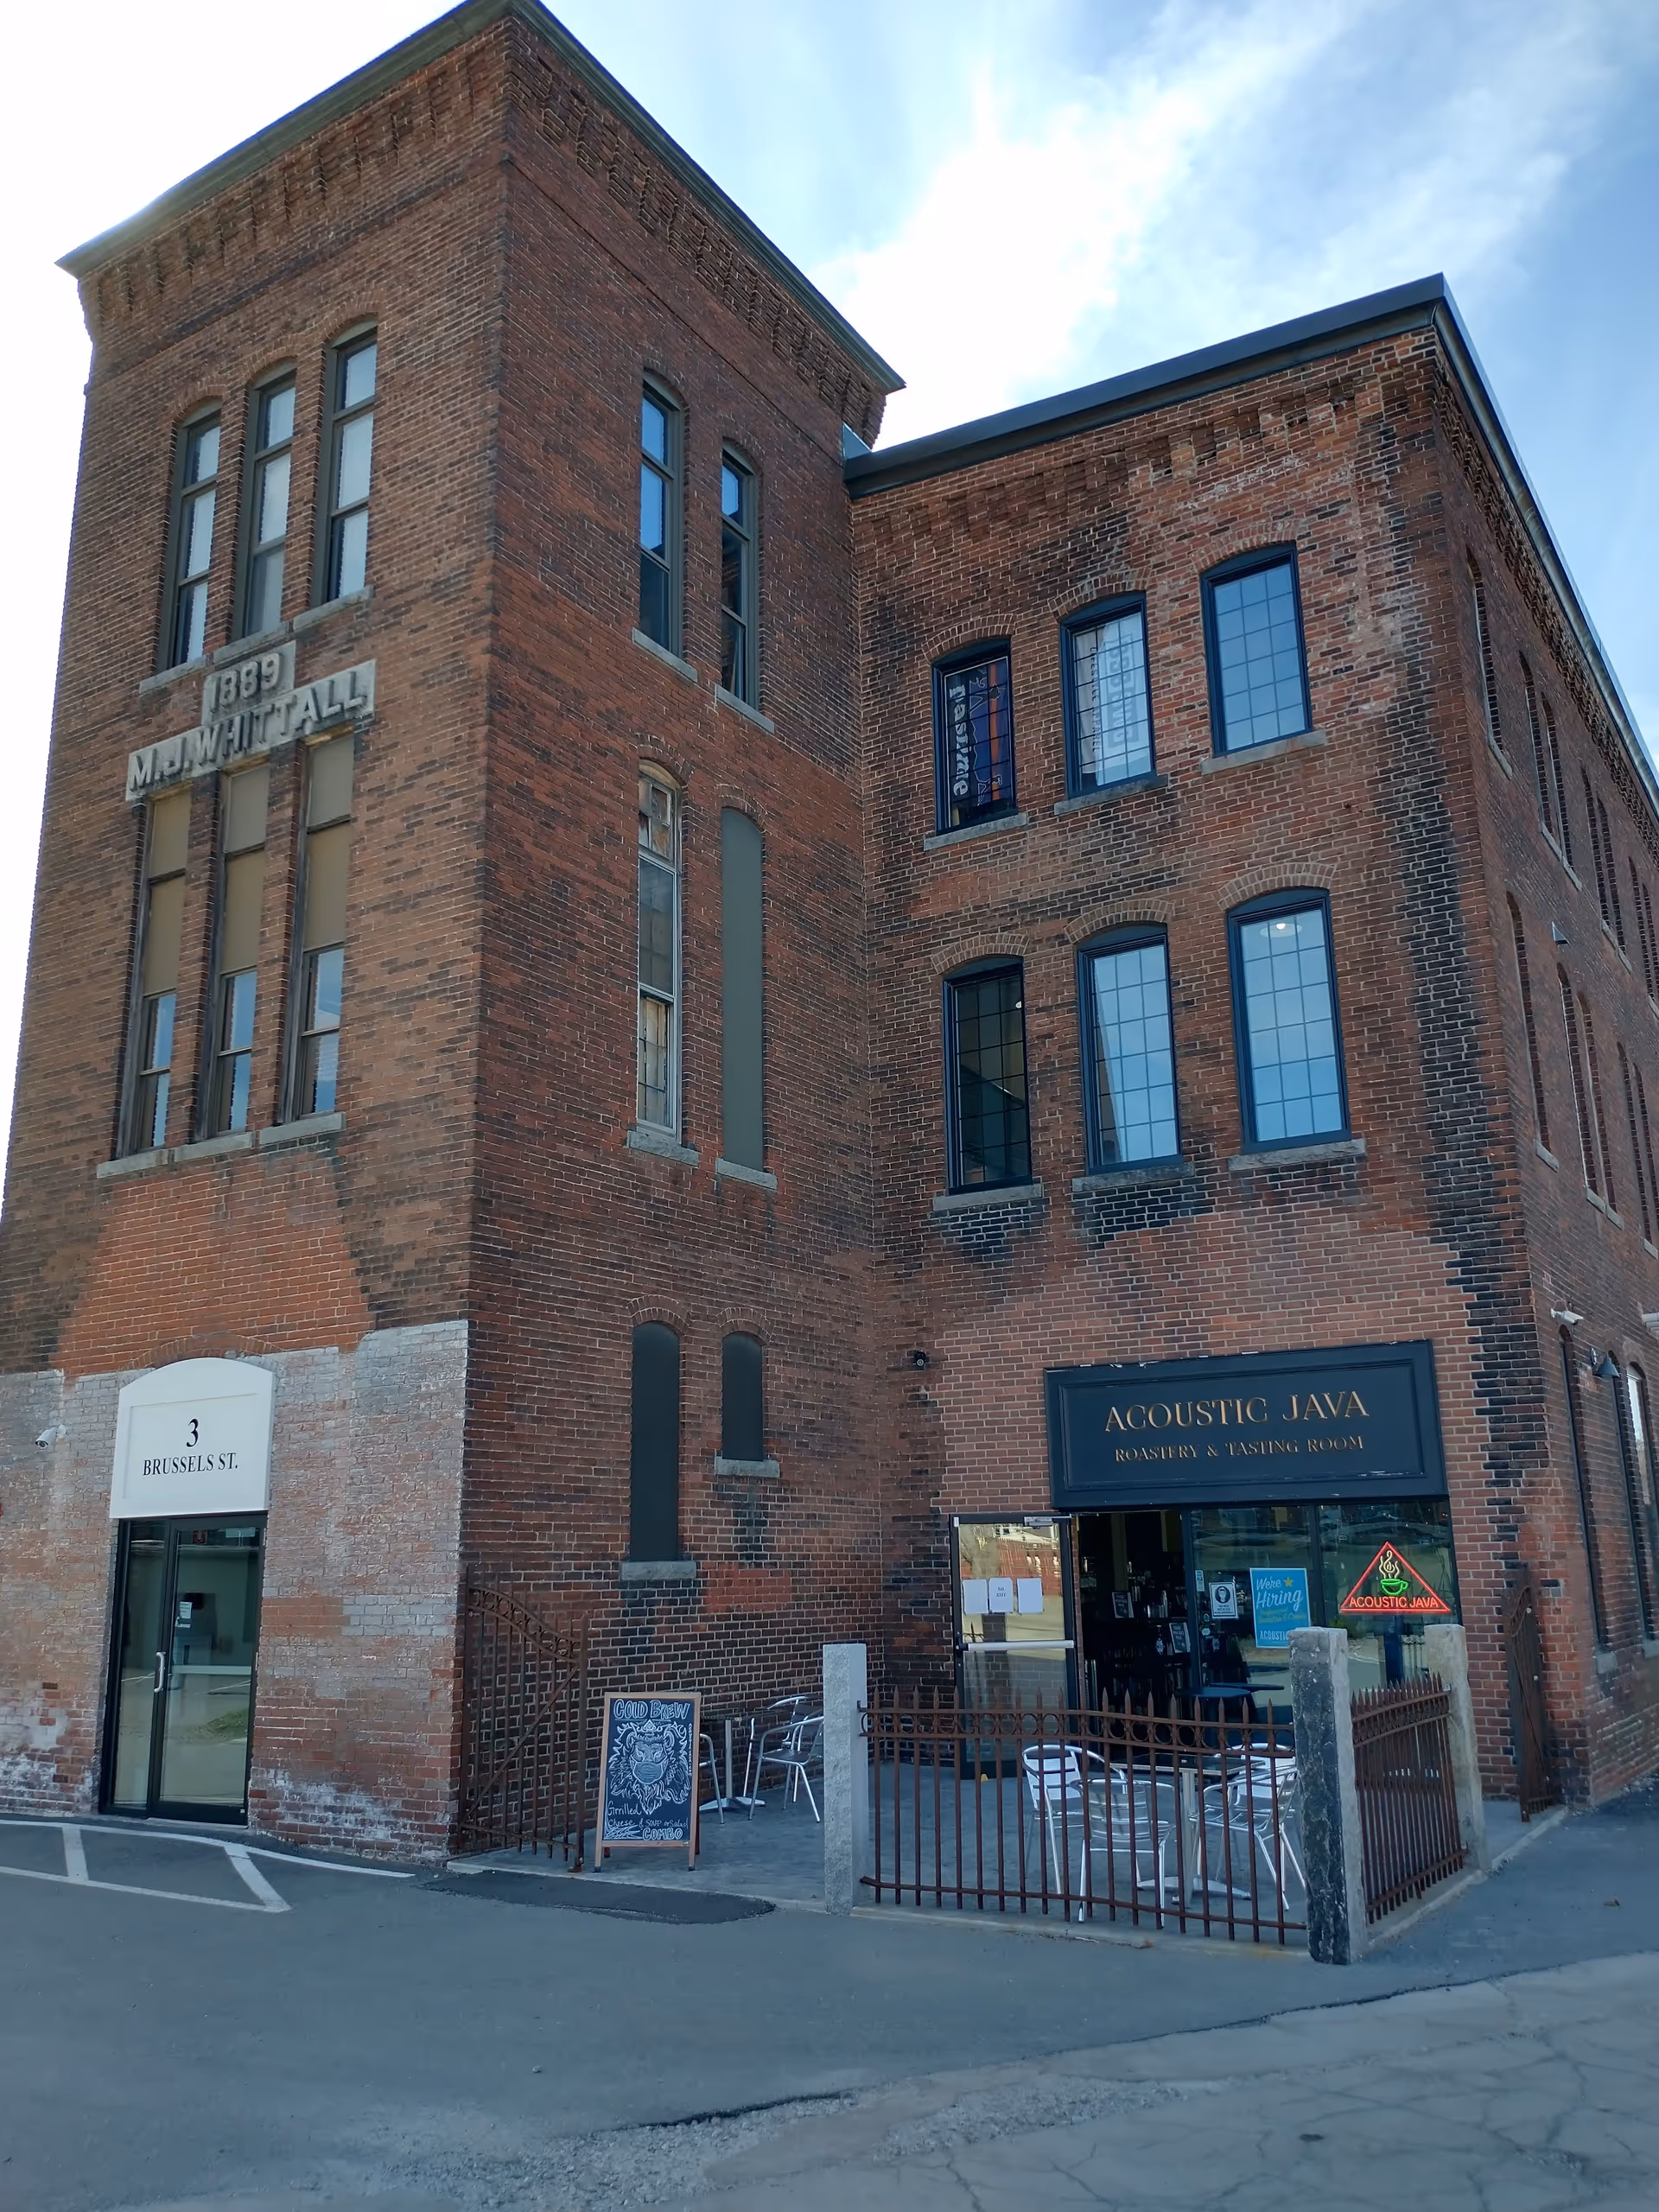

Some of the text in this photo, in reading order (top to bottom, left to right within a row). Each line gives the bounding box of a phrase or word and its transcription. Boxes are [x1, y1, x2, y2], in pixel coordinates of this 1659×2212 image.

[208, 652, 283, 714] 1889
[195, 671, 367, 766] WHITTALL
[1092, 706, 1102, 753] APPAREL
[1105, 1390, 1370, 1432] ACOUSTIC JAVA
[186, 1418, 199, 1447] 3
[1115, 1435, 1363, 1462] ROASTERY & TASTING ROOM
[143, 1452, 238, 1476] BRUSSELS ST.
[1256, 1576, 1281, 1590] We're
[1255, 1590, 1304, 1611] Hiring
[1349, 1596, 1439, 1608] ACOUSTIC JAVA
[1259, 1630, 1289, 1641] ACOUSTIC
[650, 1700, 690, 1719] BREW
[643, 1827, 683, 1840] COMBO
